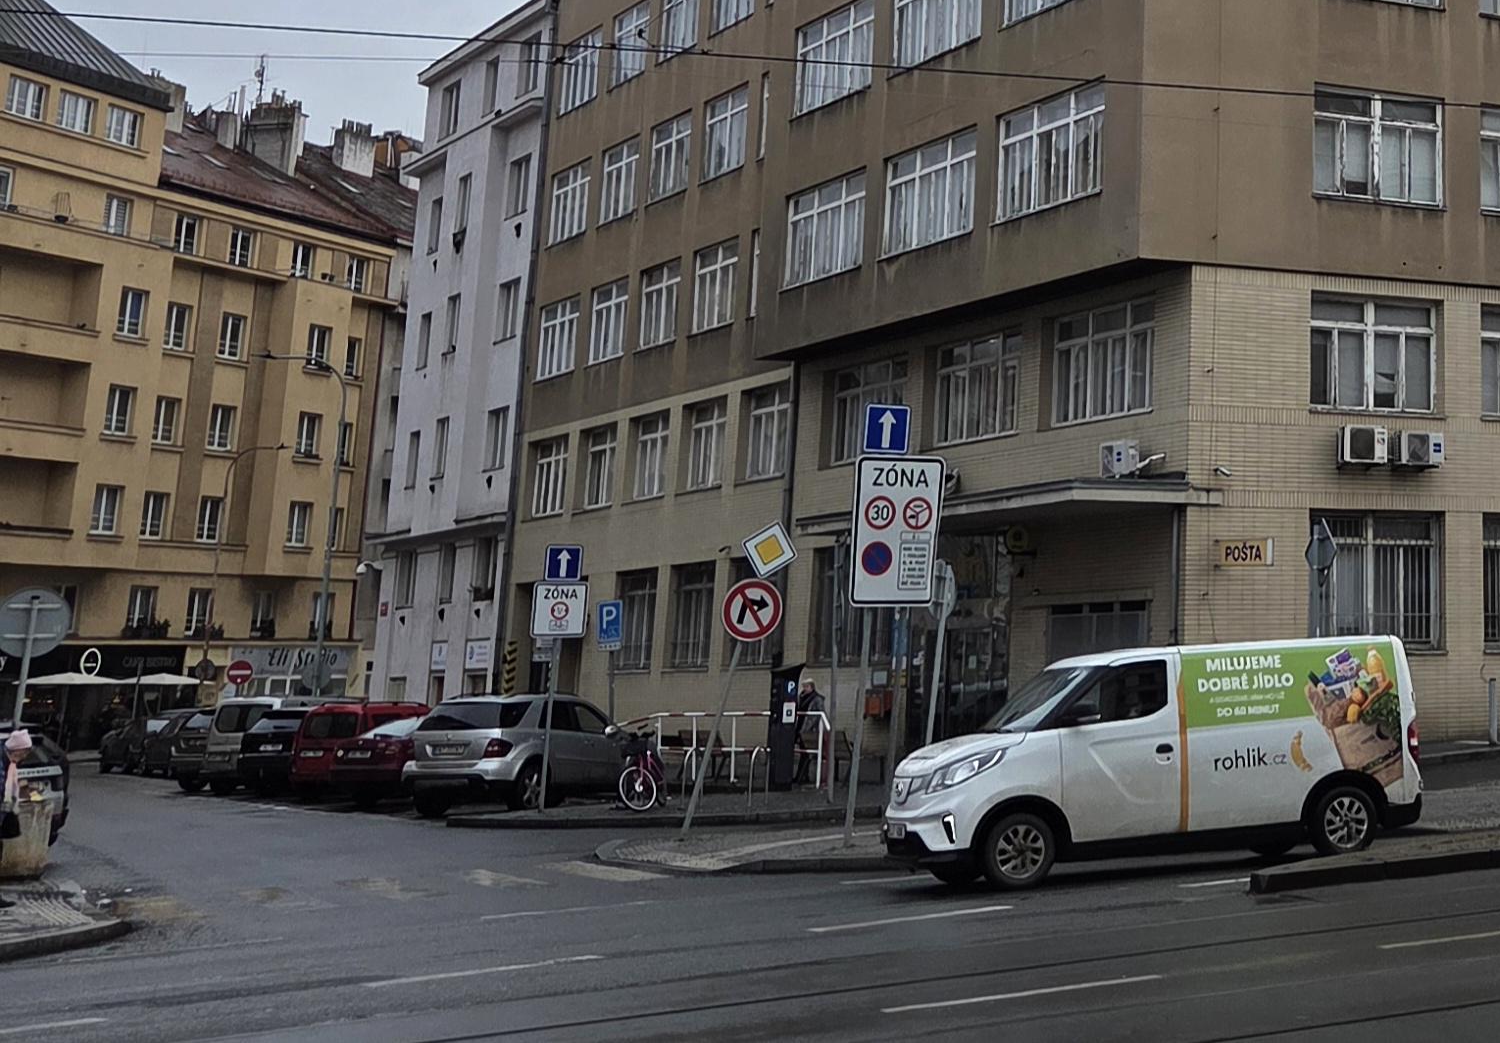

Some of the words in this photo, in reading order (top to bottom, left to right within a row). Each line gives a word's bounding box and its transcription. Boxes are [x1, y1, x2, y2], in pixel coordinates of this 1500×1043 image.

[872, 464, 929, 488] ZÓNA
[871, 504, 890, 521] 30
[1224, 541, 1262, 562] POŠTA
[543, 586, 578, 600] ZÓNA
[602, 606, 617, 630] P
[1206, 655, 1282, 672] MILUJEME
[1197, 672, 1249, 693] DOBRÉ
[1252, 671, 1294, 689] JÍDLO
[1216, 707, 1233, 717] DO
[1214, 746, 1288, 771] rohlik.cz
